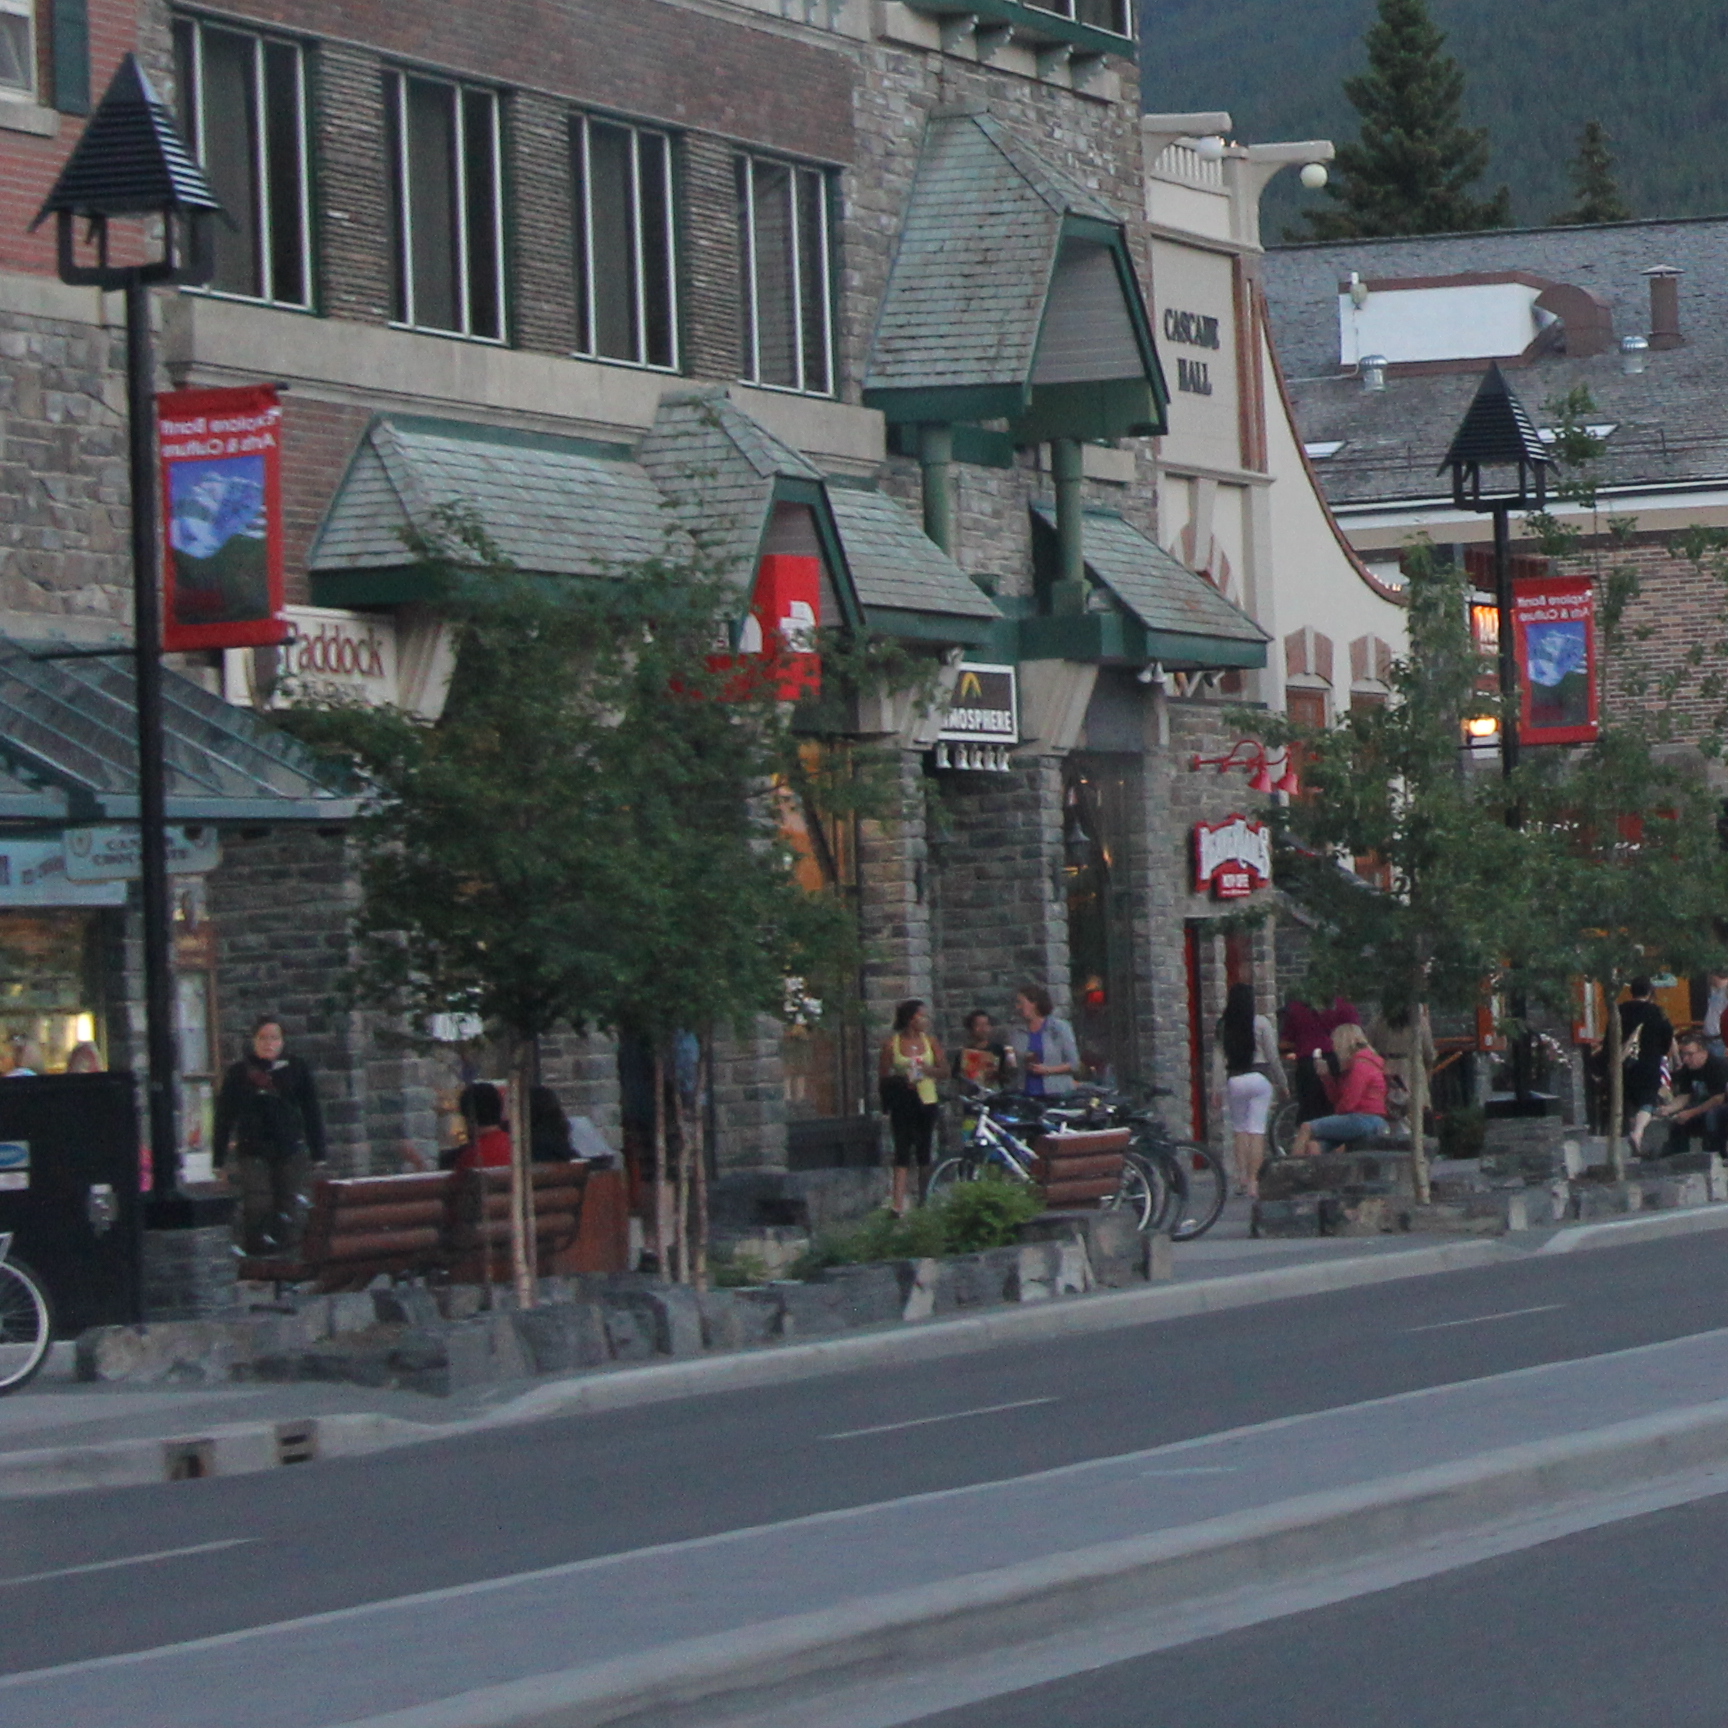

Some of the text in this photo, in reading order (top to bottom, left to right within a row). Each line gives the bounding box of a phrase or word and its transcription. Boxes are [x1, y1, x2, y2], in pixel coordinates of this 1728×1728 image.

[1177, 358, 1212, 396] HALL
[286, 623, 386, 678] Paddock
[943, 707, 1012, 732] MOSPHERE
